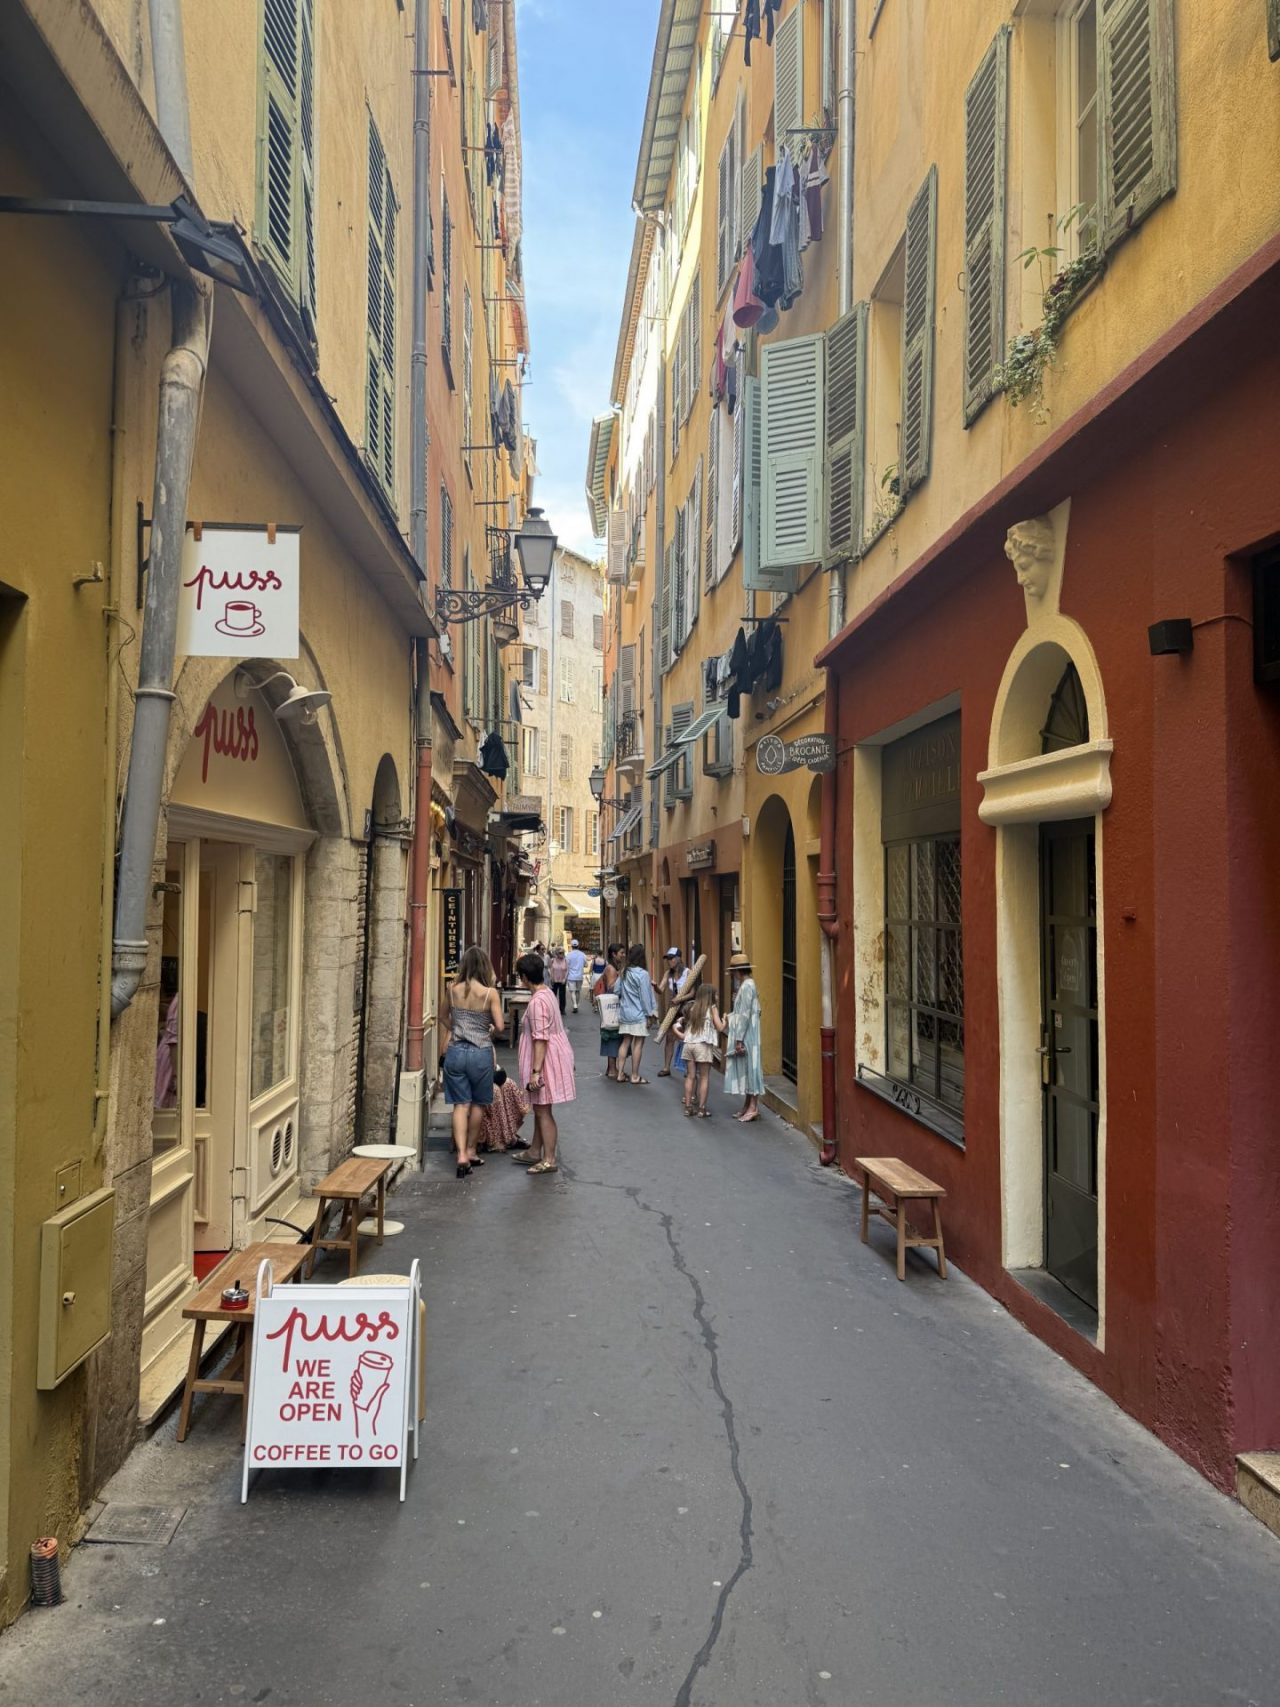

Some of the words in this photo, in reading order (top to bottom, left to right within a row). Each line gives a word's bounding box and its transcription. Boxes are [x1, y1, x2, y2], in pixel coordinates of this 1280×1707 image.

[184, 565, 282, 610] puss
[195, 702, 259, 784] puss
[789, 743, 831, 757] BROCANTE
[447, 896, 457, 955] CEINTURES
[266, 1307, 399, 1373] puss
[296, 1359, 331, 1377] WE
[288, 1381, 335, 1399] ARE
[279, 1403, 342, 1421] OPEN
[253, 1444, 331, 1461] COFFEE
[337, 1444, 363, 1460] TO
[369, 1444, 398, 1460] GO
